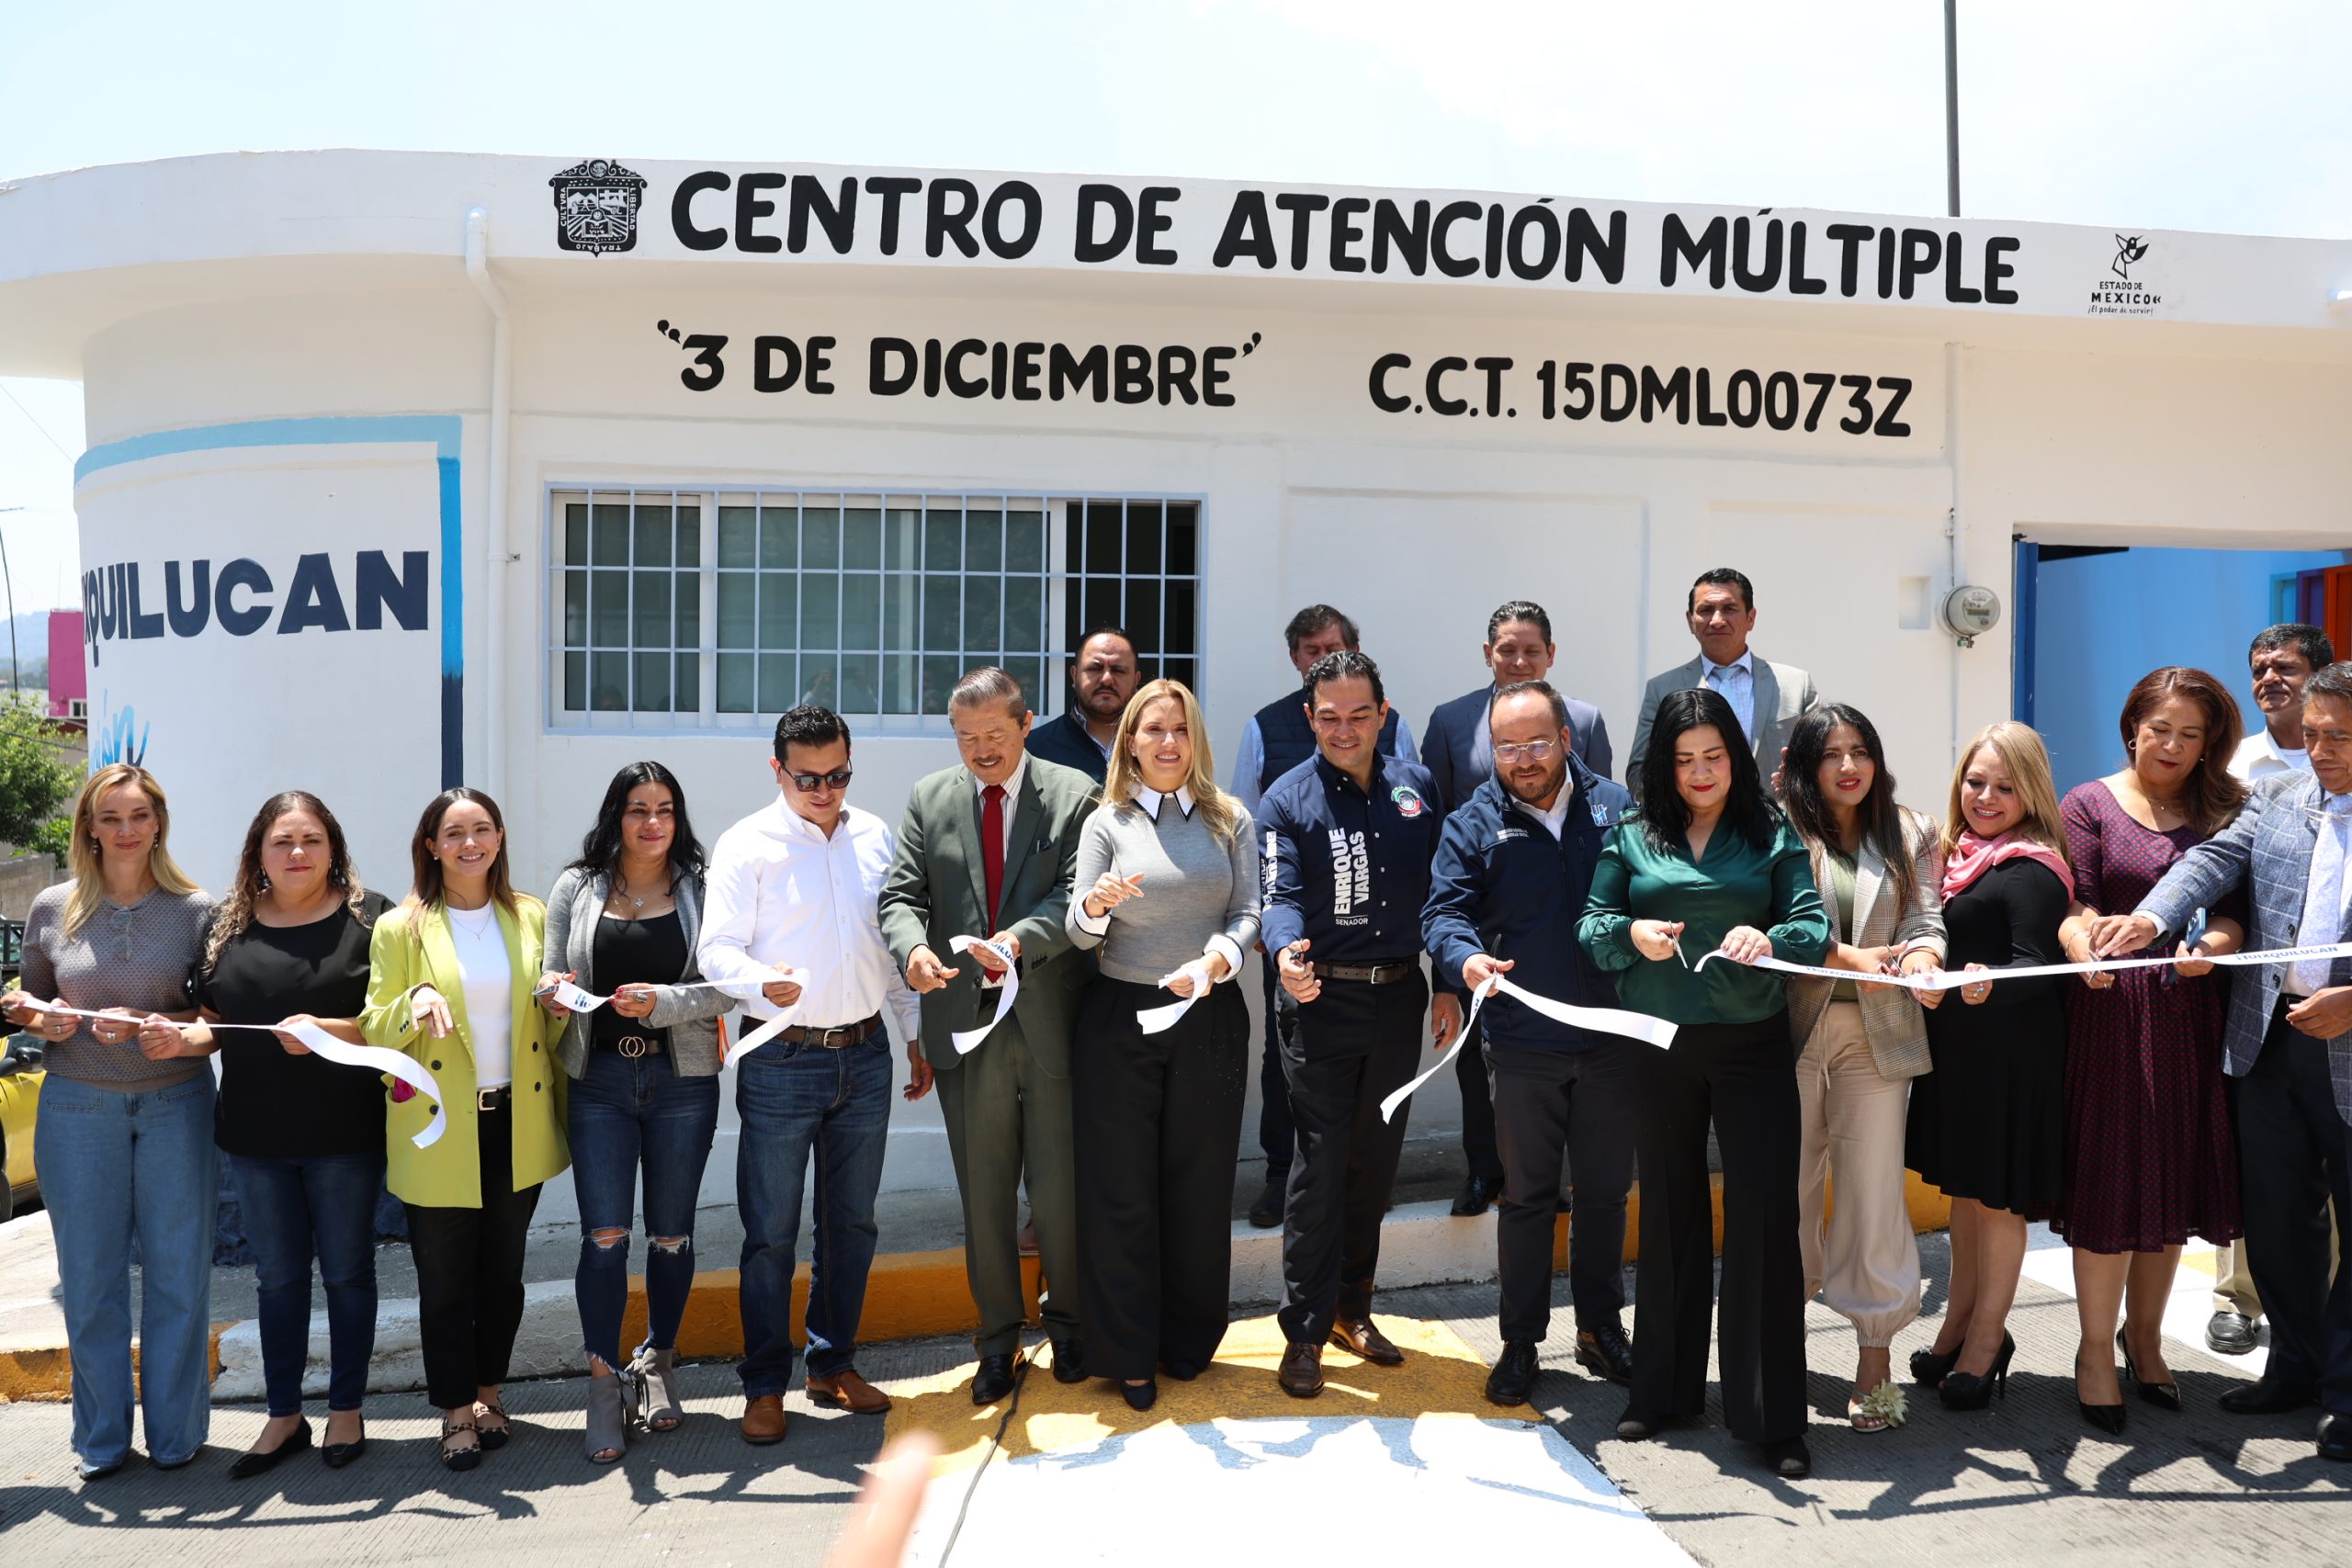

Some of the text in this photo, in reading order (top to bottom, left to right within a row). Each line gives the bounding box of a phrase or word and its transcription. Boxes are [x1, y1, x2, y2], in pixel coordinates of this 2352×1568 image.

[575, 243, 621, 252] TRABAJO
[671, 171, 2020, 305] CENTRO DE ATENCIÓN MÚLTIPLE
[2099, 281, 2143, 290] ESTADO DE
[753, 335, 837, 395] DE
[1369, 353, 1913, 437] C.C.T. 15DML0073Z
[1329, 828, 1351, 914] ENRIQUE
[1350, 831, 1370, 906] VARGAS
[1335, 918, 1369, 926] SENADOR
